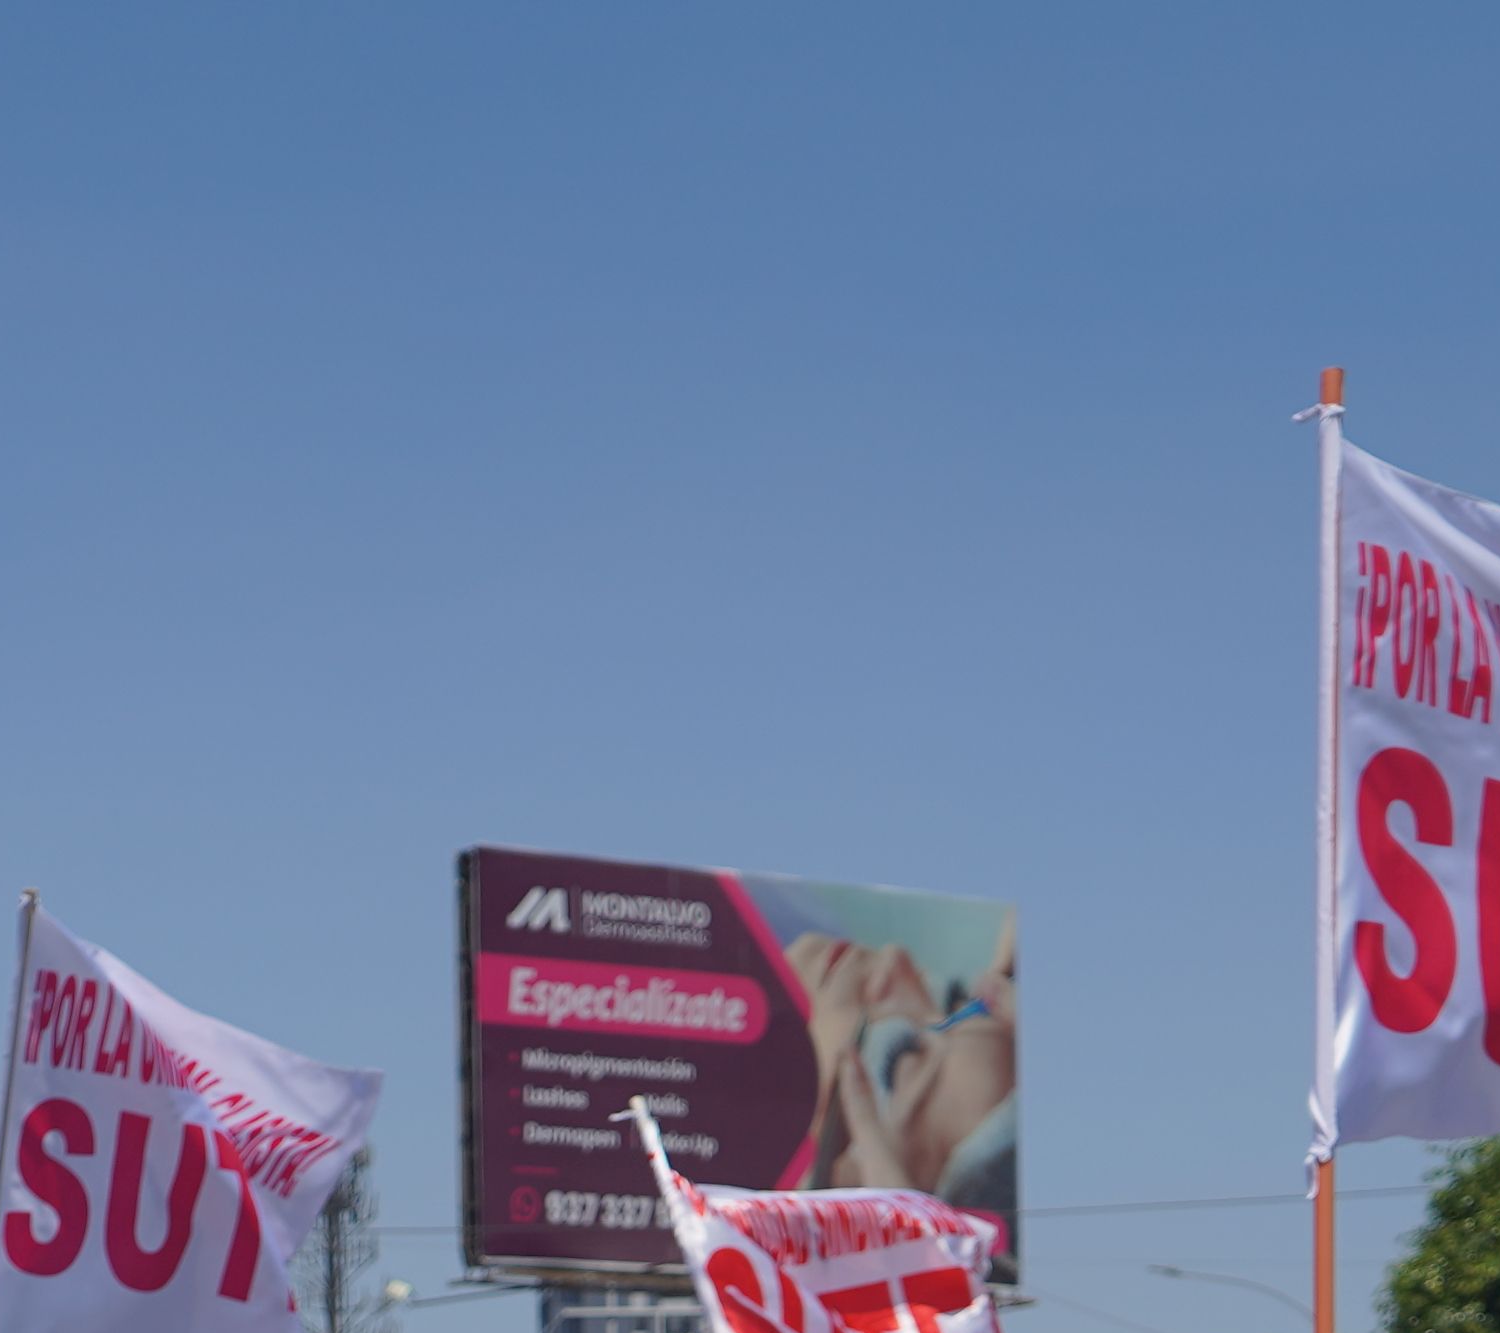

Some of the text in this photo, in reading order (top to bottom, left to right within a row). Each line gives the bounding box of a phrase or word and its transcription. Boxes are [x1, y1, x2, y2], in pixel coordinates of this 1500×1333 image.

[1353, 541, 1441, 707] ¡POR
[1445, 574, 1493, 723] LA
[3, 1097, 264, 1306] SUT
